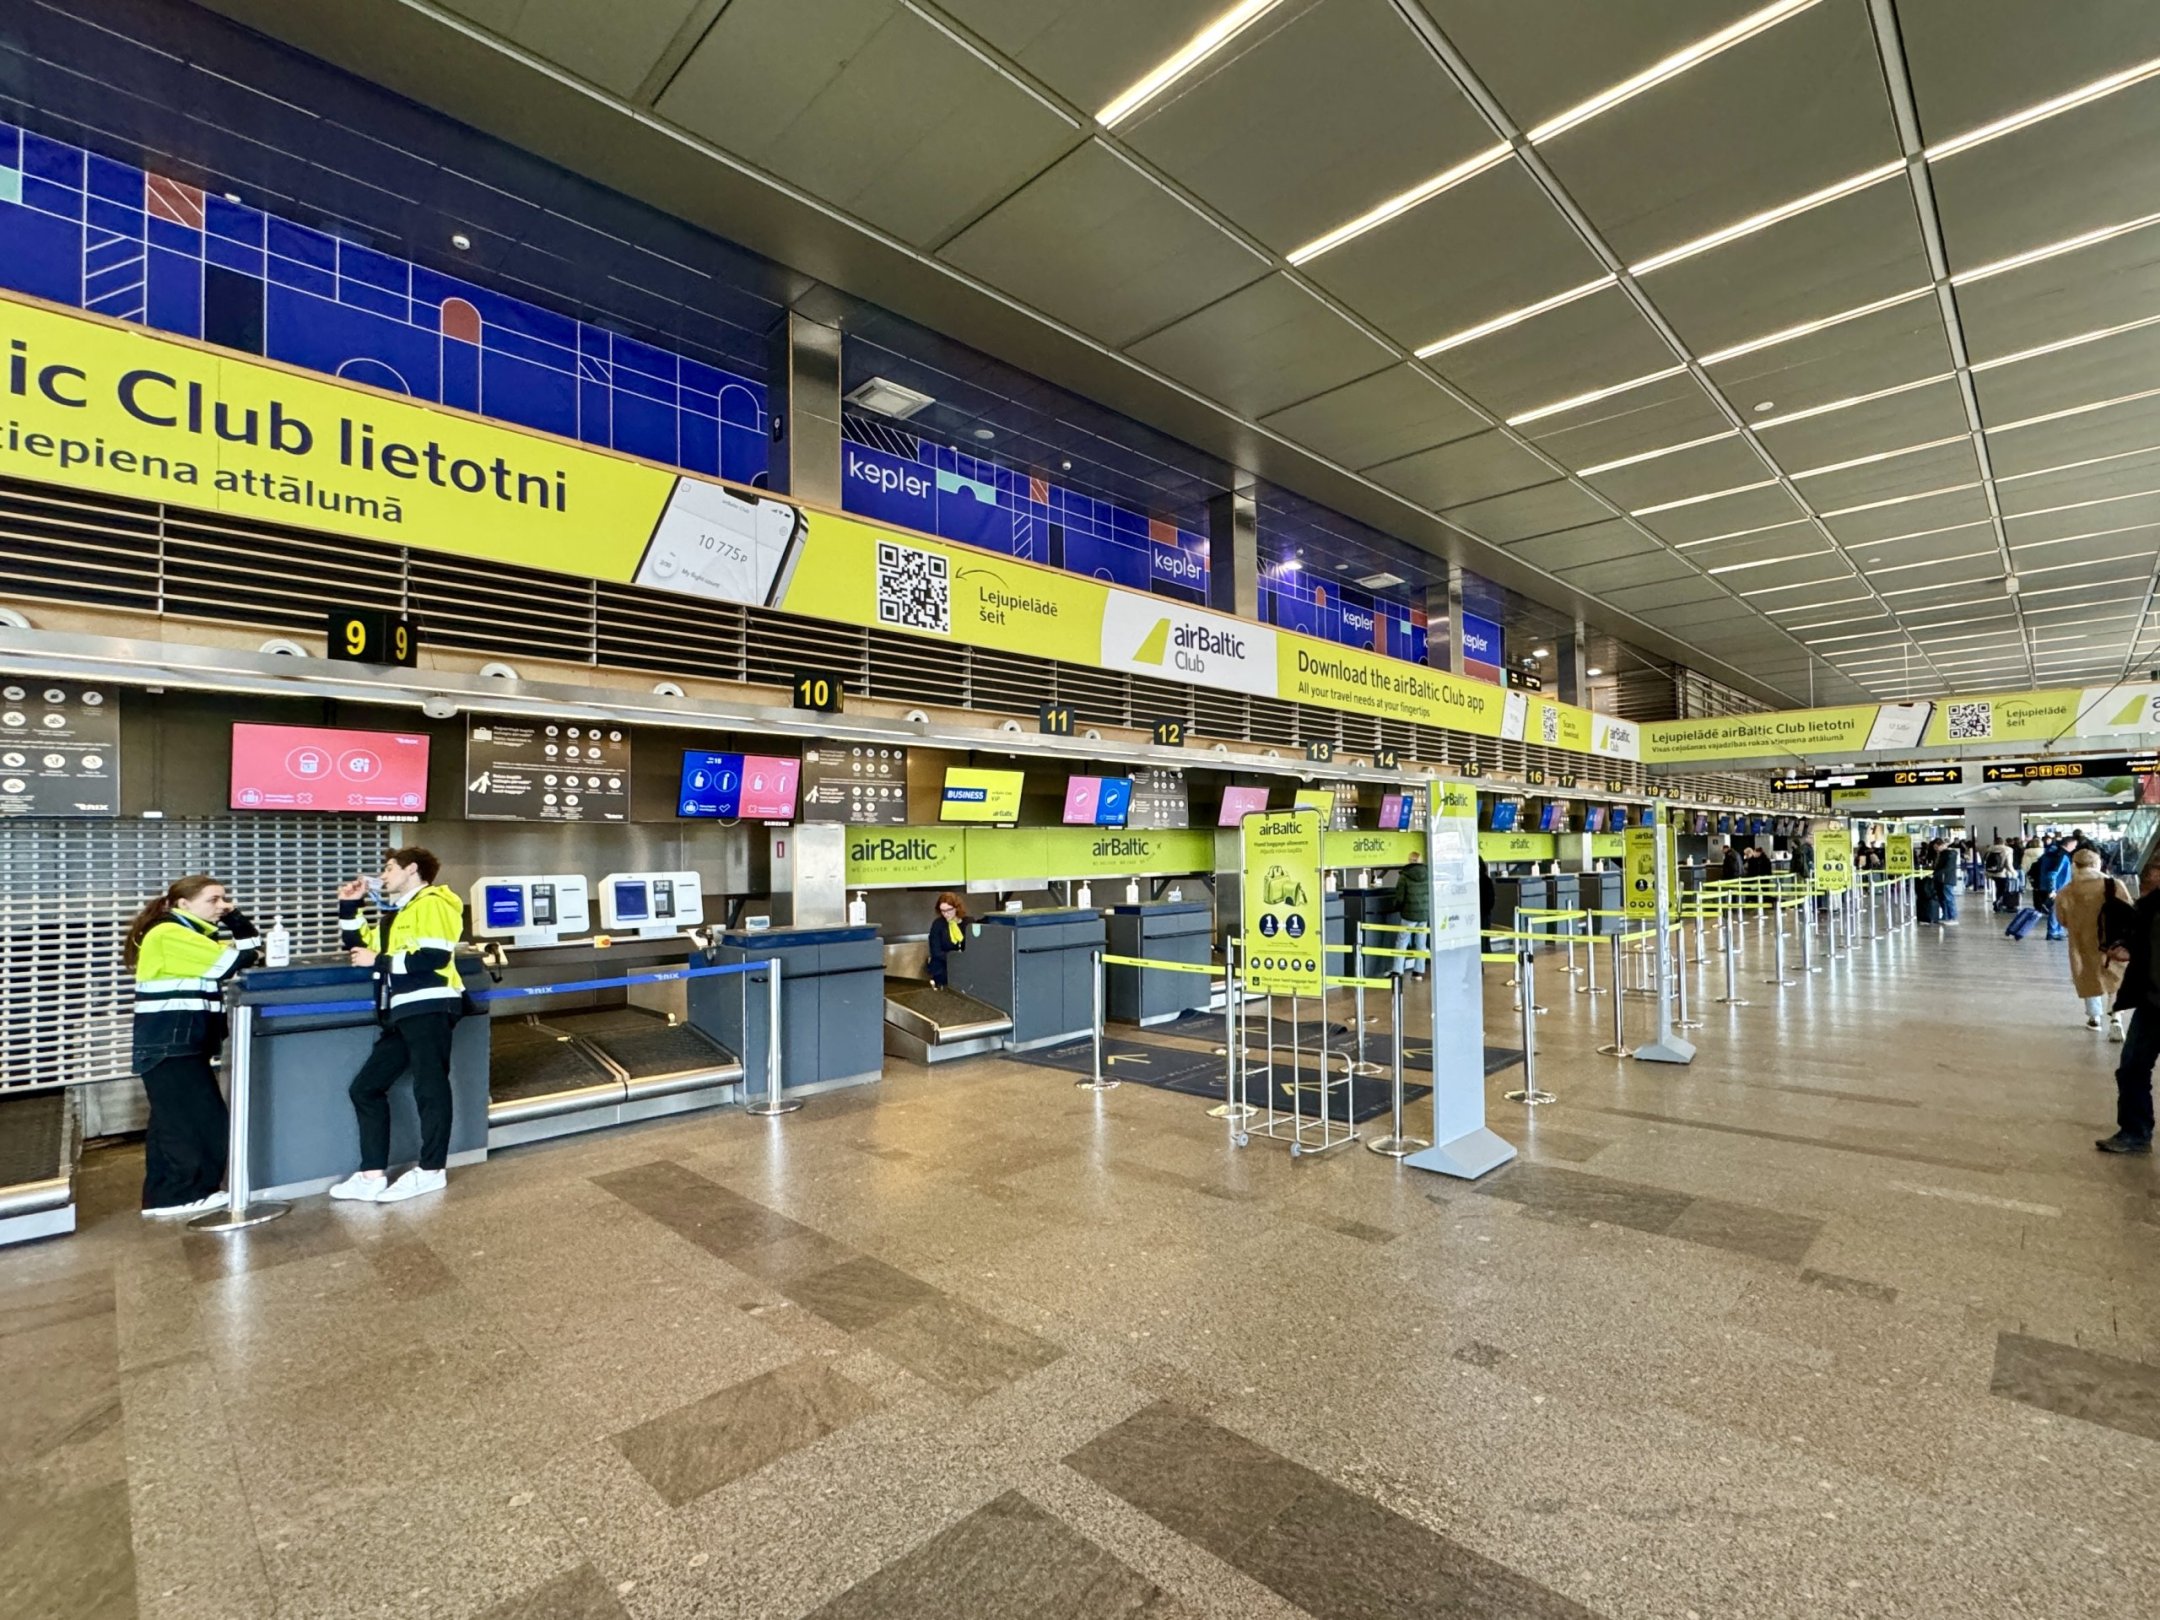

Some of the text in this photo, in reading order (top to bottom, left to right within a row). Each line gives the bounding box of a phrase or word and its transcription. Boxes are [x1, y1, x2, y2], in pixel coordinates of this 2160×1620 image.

[9, 338, 567, 513] ic Club lietotni
[849, 451, 932, 499] kepler
[212, 448, 403, 524] attālumā
[698, 533, 714, 550] 10
[1154, 550, 1202, 580] kepler
[979, 586, 1059, 617] Lejupielādē
[979, 608, 1006, 626] šeit
[1343, 607, 1374, 632] kepler
[346, 620, 366, 656] 9
[396, 626, 408, 661] 9
[1173, 623, 1246, 661] airBaltic
[1462, 628, 1488, 652] kepler
[1174, 650, 1205, 673] Club
[1298, 649, 1486, 714] Download the airBaltic Club app
[800, 679, 829, 707] 10
[1298, 680, 1431, 719] All your travel needs at your fingertips
[1047, 710, 1068, 732] 11
[2006, 706, 2067, 719] Lejupielādē
[2006, 717, 2025, 727] šeit
[1158, 723, 1180, 744] 12
[1652, 720, 1855, 744] Lejupielādē airBaltic Club lietotni
[1310, 742, 1329, 760] 13
[1378, 751, 1395, 768] 14
[1464, 762, 1479, 776] 15
[1529, 770, 1542, 783] 16
[1907, 772, 1917, 784] C
[1561, 775, 1574, 787] 17
[1608, 781, 1621, 792] 18
[947, 788, 984, 801] BUSINESS
[1648, 786, 1659, 796] 19
[1669, 788, 1680, 798] 20
[1699, 793, 1708, 801] 21
[1725, 795, 1734, 803] 22
[1747, 797, 1756, 806] 23
[1765, 800, 1775, 808] 24
[1259, 821, 1303, 836] airBaltic
[851, 838, 938, 861] airBaltic
[1092, 838, 1149, 857] airBaltic
[1353, 838, 1384, 852] airBaltic
[1265, 915, 1273, 928] 1
[1291, 915, 1299, 929] 1
